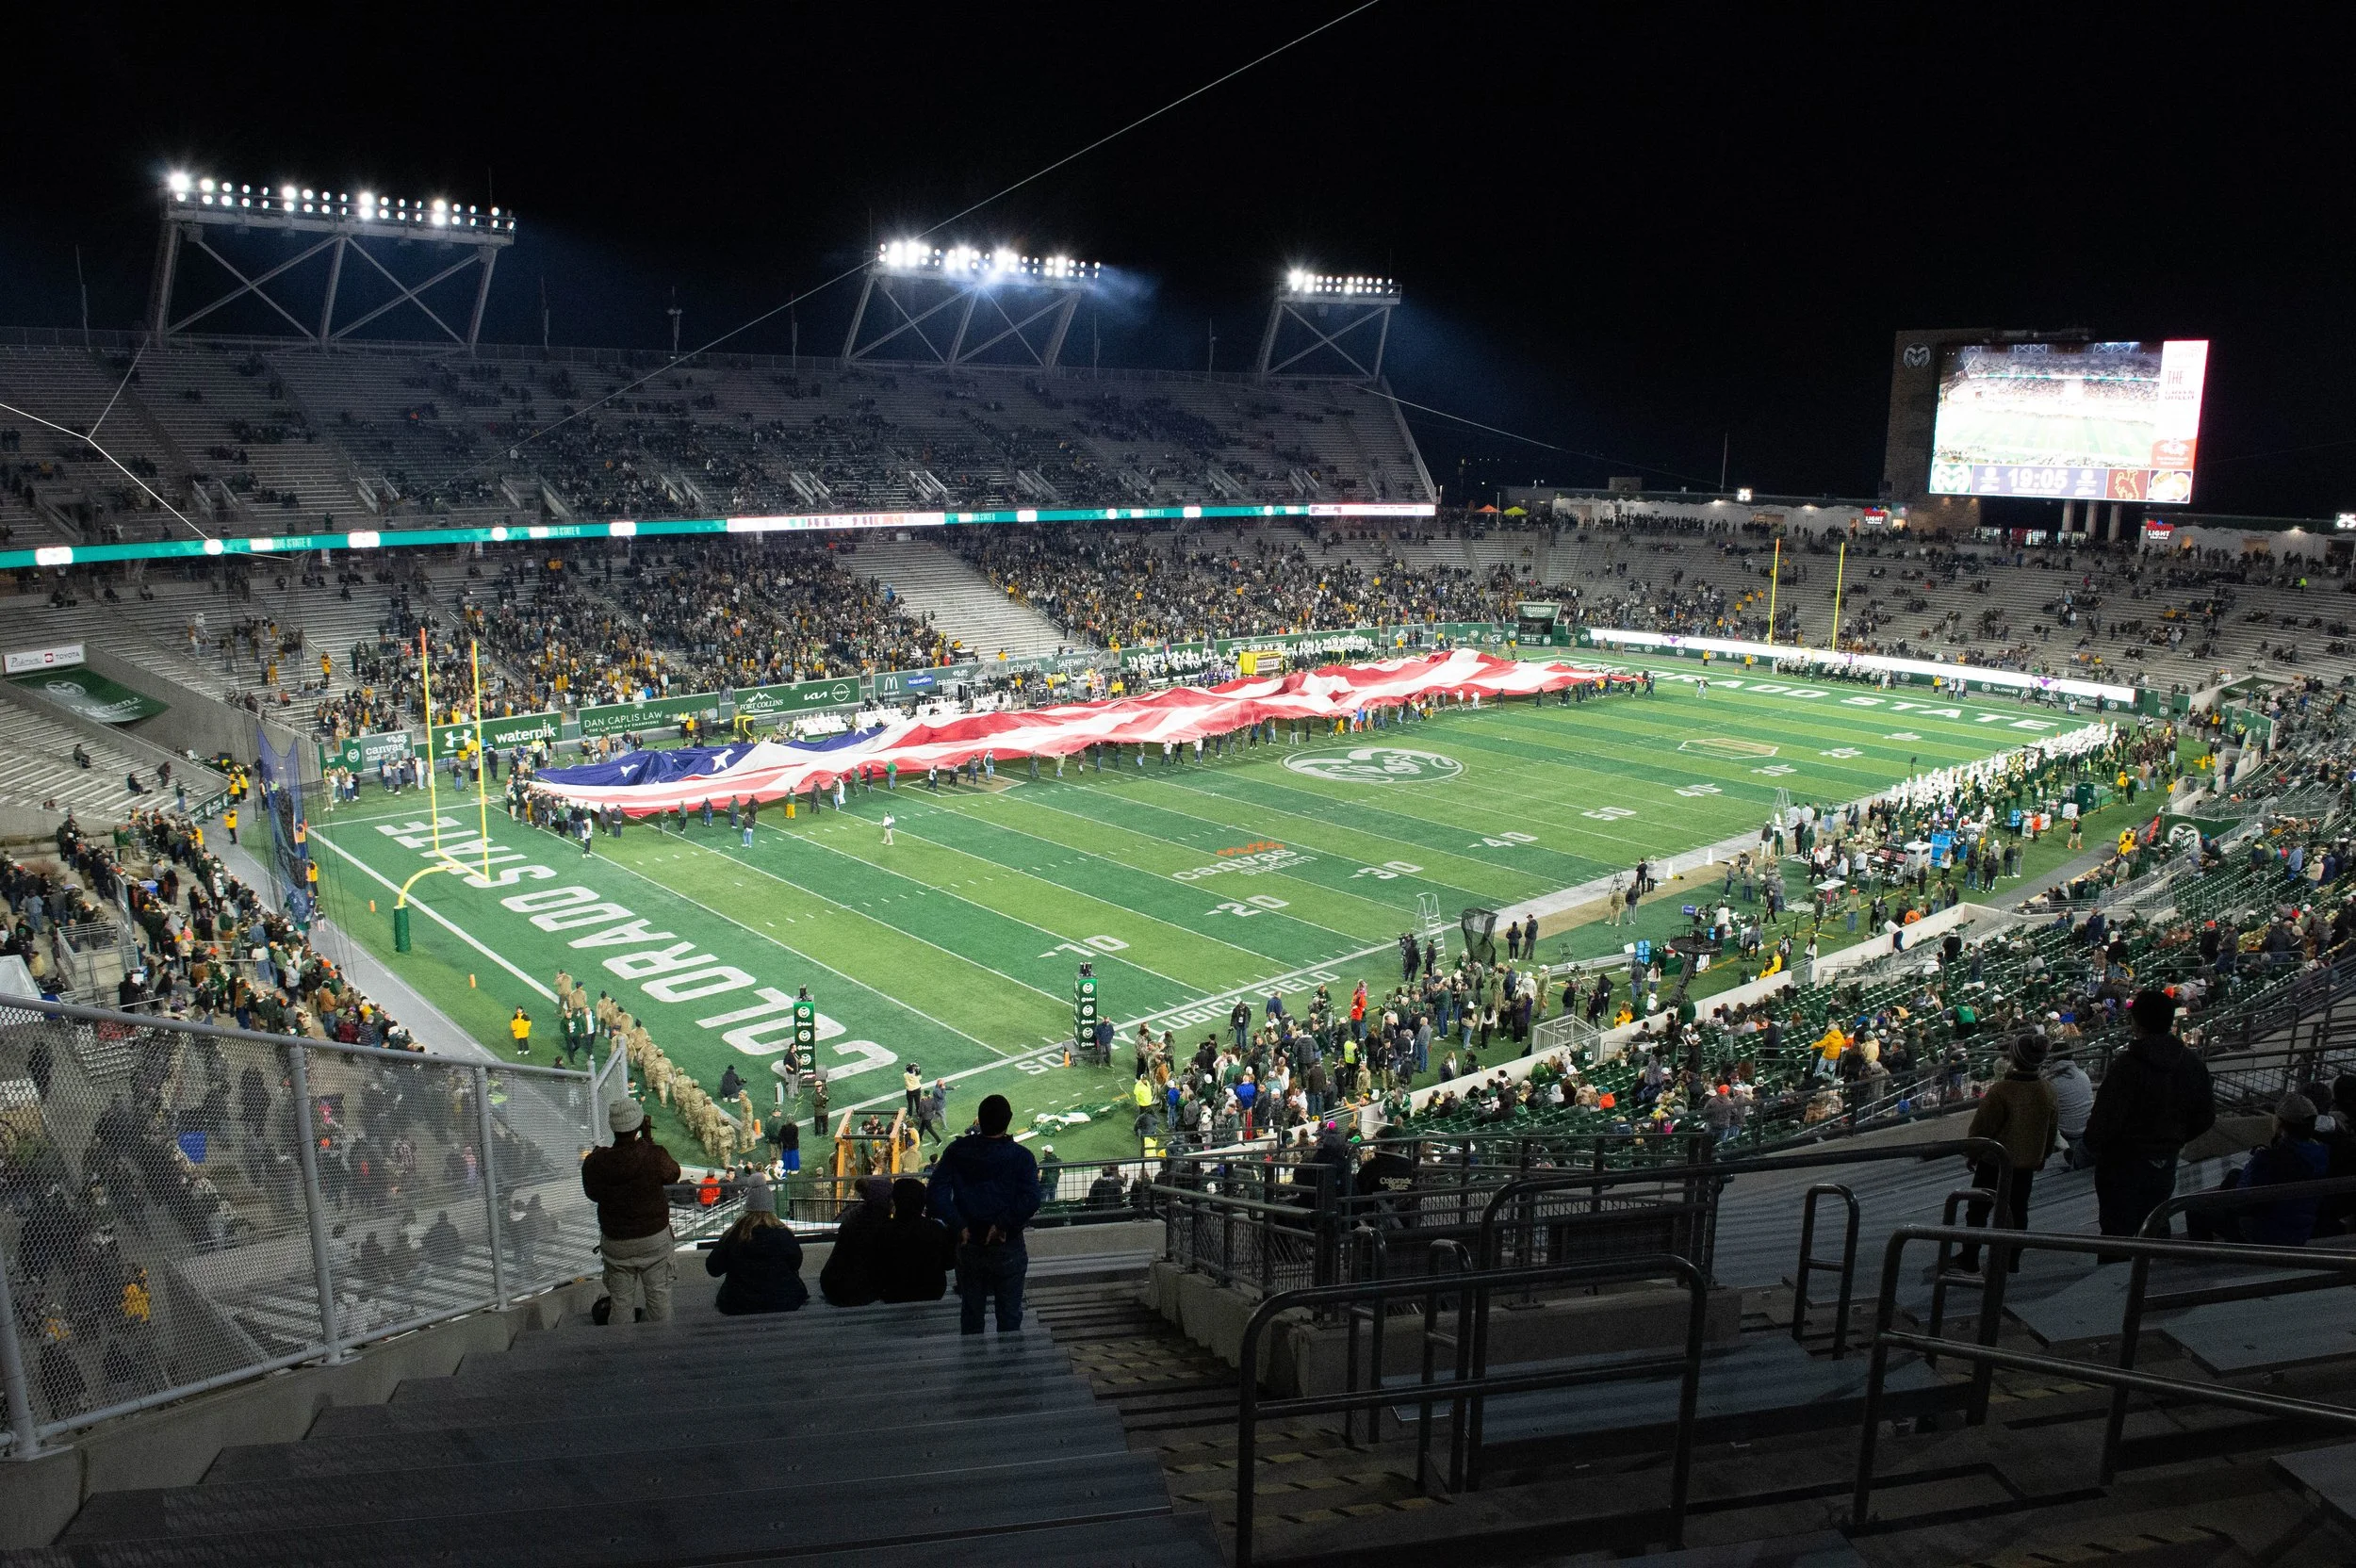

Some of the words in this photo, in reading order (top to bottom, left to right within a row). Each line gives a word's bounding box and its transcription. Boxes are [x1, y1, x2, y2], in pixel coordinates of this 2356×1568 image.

[2168, 370, 2184, 385] THE
[2008, 468, 2069, 489] 19:05
[286, 538, 305, 548] STATE
[1056, 659, 1087, 668] SAFEWAY
[740, 700, 756, 710] FORT
[757, 698, 783, 709] COLLINS
[1841, 696, 2060, 730] STATE
[584, 717, 605, 728] DAN
[608, 713, 640, 726] CAPLIS
[643, 710, 663, 720] LAW
[631, 720, 660, 728] CHAMPIONS
[495, 719, 556, 743] waterpik
[366, 743, 404, 756] canvas
[1674, 783, 1723, 797] 40
[1580, 806, 1637, 821] 50
[1482, 831, 1539, 848] 40
[1172, 849, 1298, 881] canvas
[1239, 856, 1318, 876] stadium
[1357, 860, 1424, 880] 30
[1217, 894, 1290, 918] 20
[375, 816, 558, 889] STATE
[500, 886, 898, 1082] COLORADO
[1054, 934, 1130, 957] 10
[1150, 995, 1259, 1037] LUBICK
[1254, 970, 1341, 1000] FIELD
